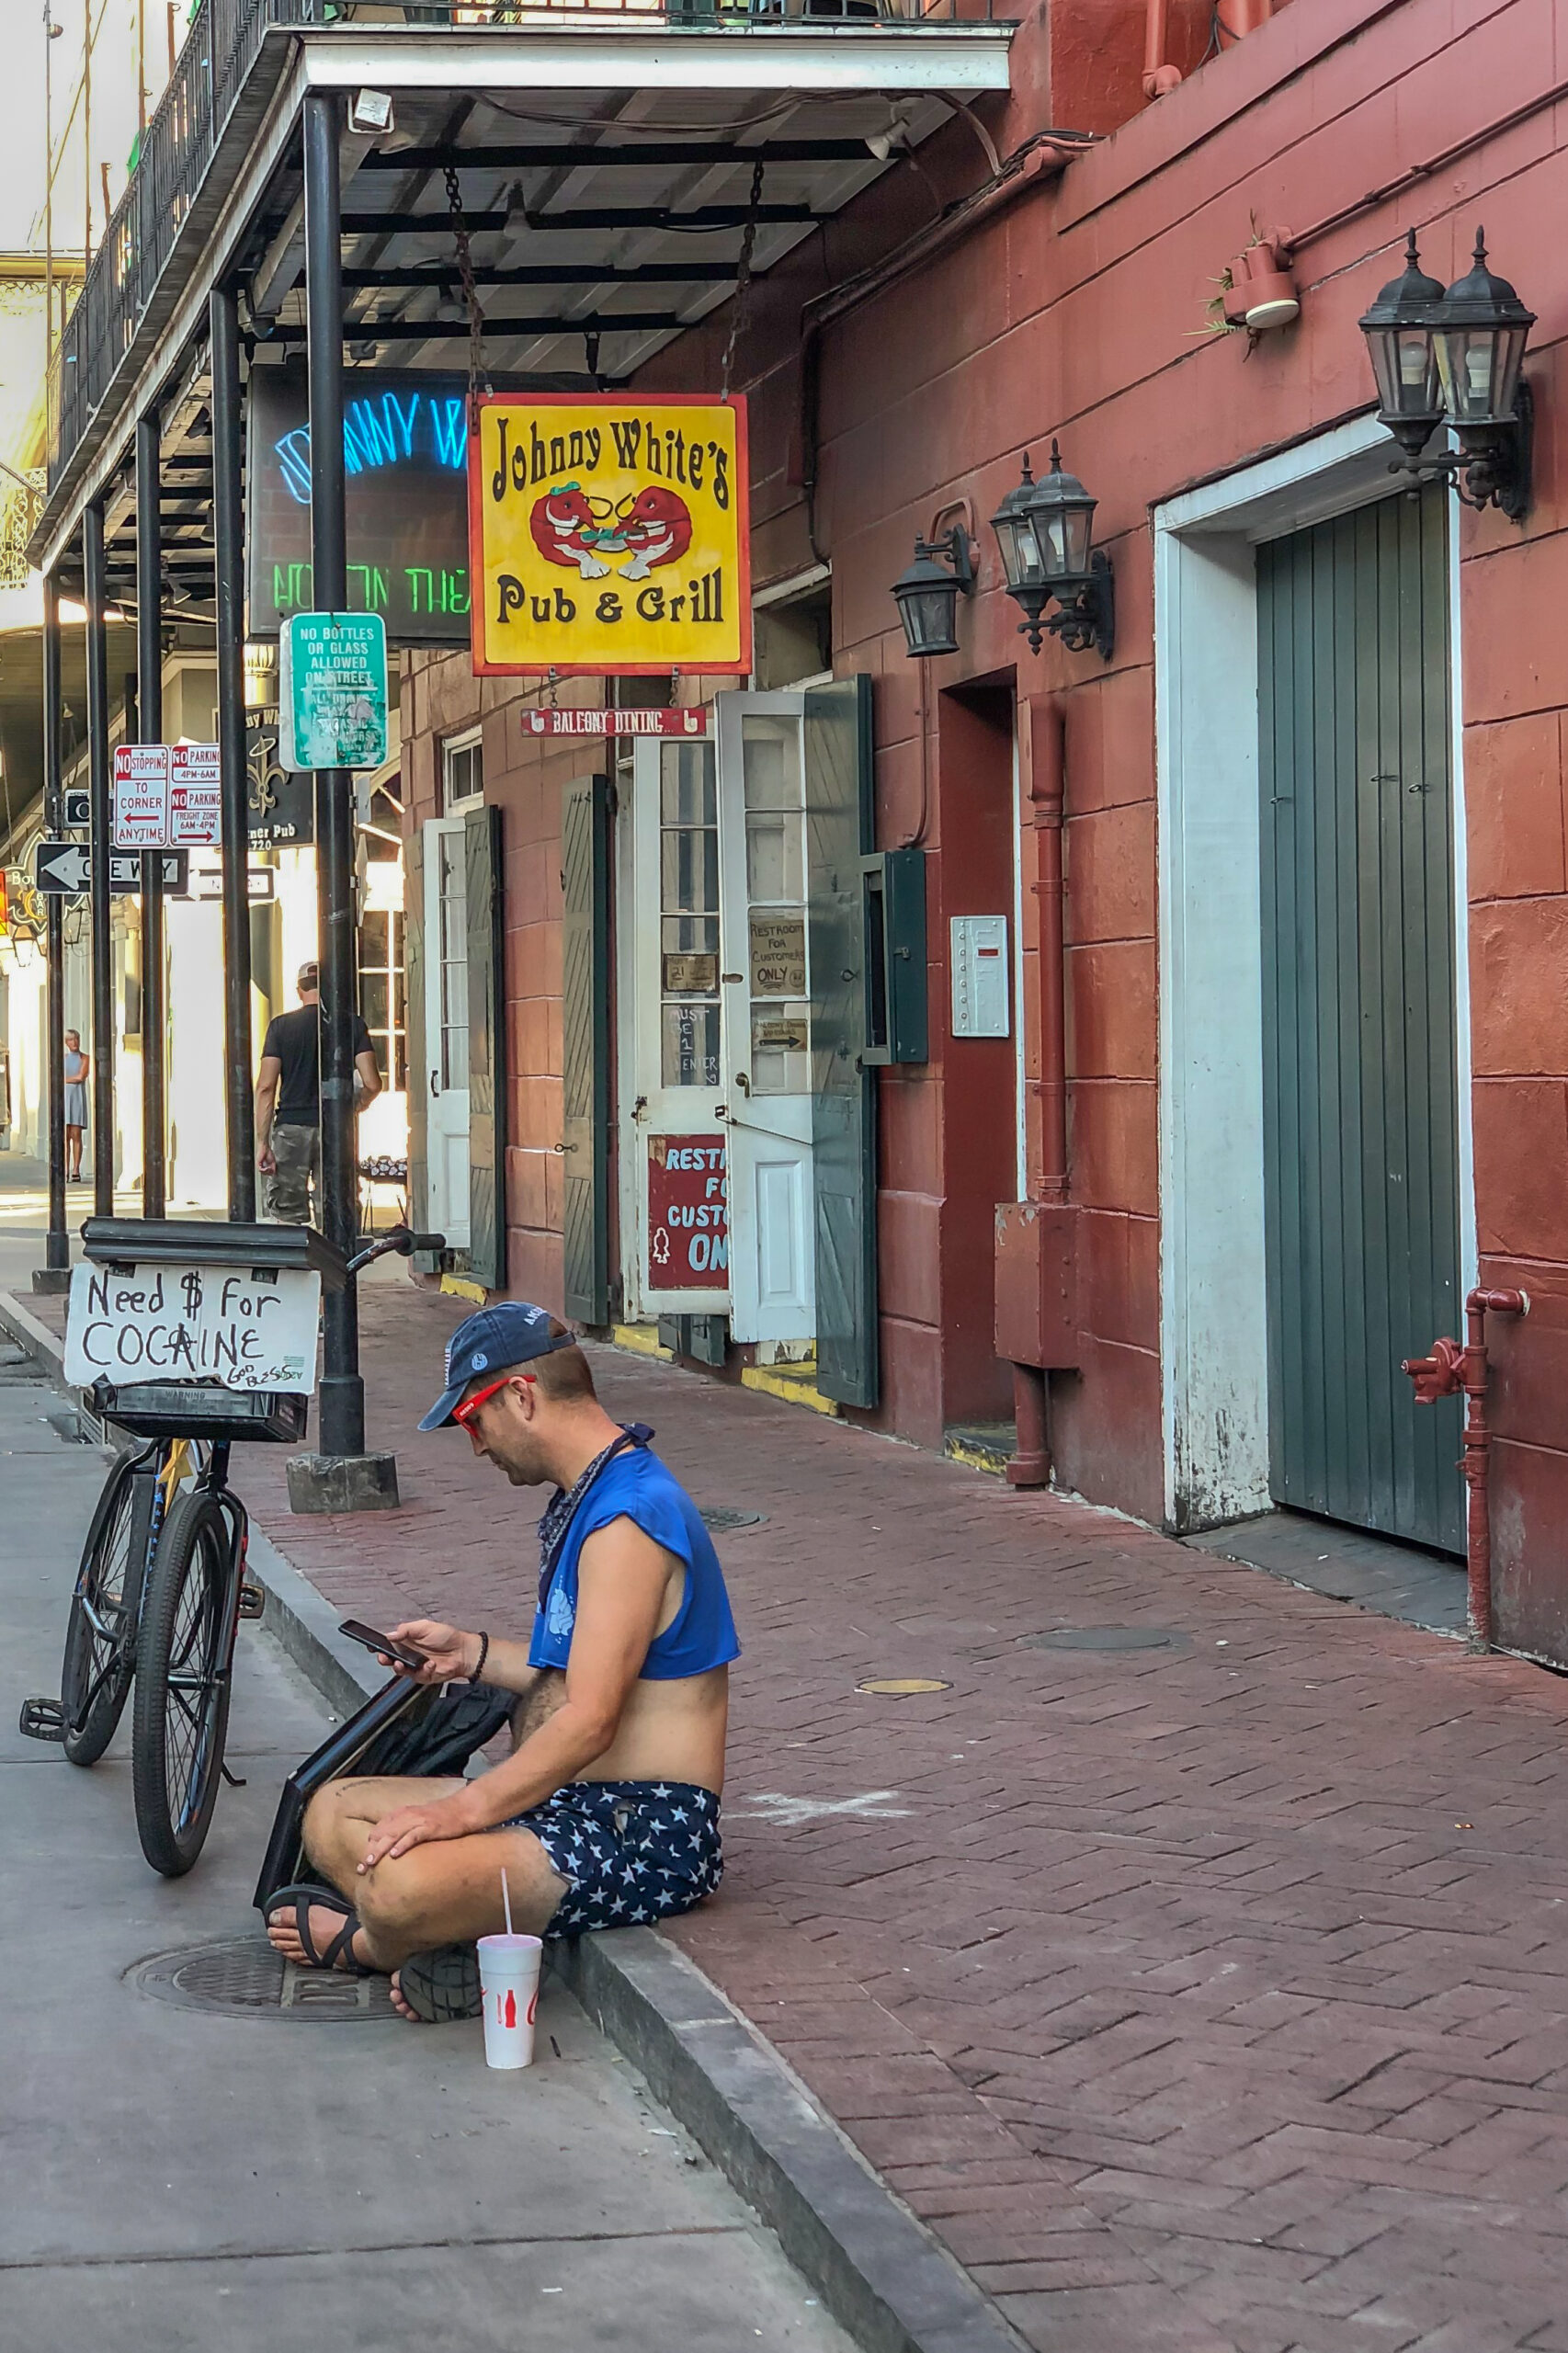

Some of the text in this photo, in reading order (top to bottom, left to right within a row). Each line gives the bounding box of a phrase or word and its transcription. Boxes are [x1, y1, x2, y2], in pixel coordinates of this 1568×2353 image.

[492, 417, 729, 510] Johnny White's
[496, 566, 724, 623] Pub & Grill
[301, 628, 374, 641] NO BOTTLES
[308, 642, 369, 654] OR GLASS
[311, 657, 367, 669] ALLOWED
[552, 711, 608, 733] BALCONY
[173, 751, 187, 764] NO
[117, 755, 166, 774] NO STOPPING
[181, 770, 216, 779] 4PM-6AM
[135, 782, 148, 793] TO
[120, 798, 162, 809] CORNER
[172, 794, 221, 806] NO PARKING
[176, 812, 219, 820] FREIGHT ZONE
[180, 822, 216, 830] 6AM-4PM
[274, 824, 295, 838] Pub
[119, 828, 164, 840] ANYTIME
[36, 892, 44, 916] BAR
[750, 924, 803, 937] RESTROOM
[768, 938, 786, 949] FOR
[757, 966, 788, 982] ONLY
[87, 1270, 164, 1316] Need
[180, 1271, 202, 1321] $
[83, 1321, 264, 1371] COCAINE
[165, 1391, 206, 1400] WARNING
